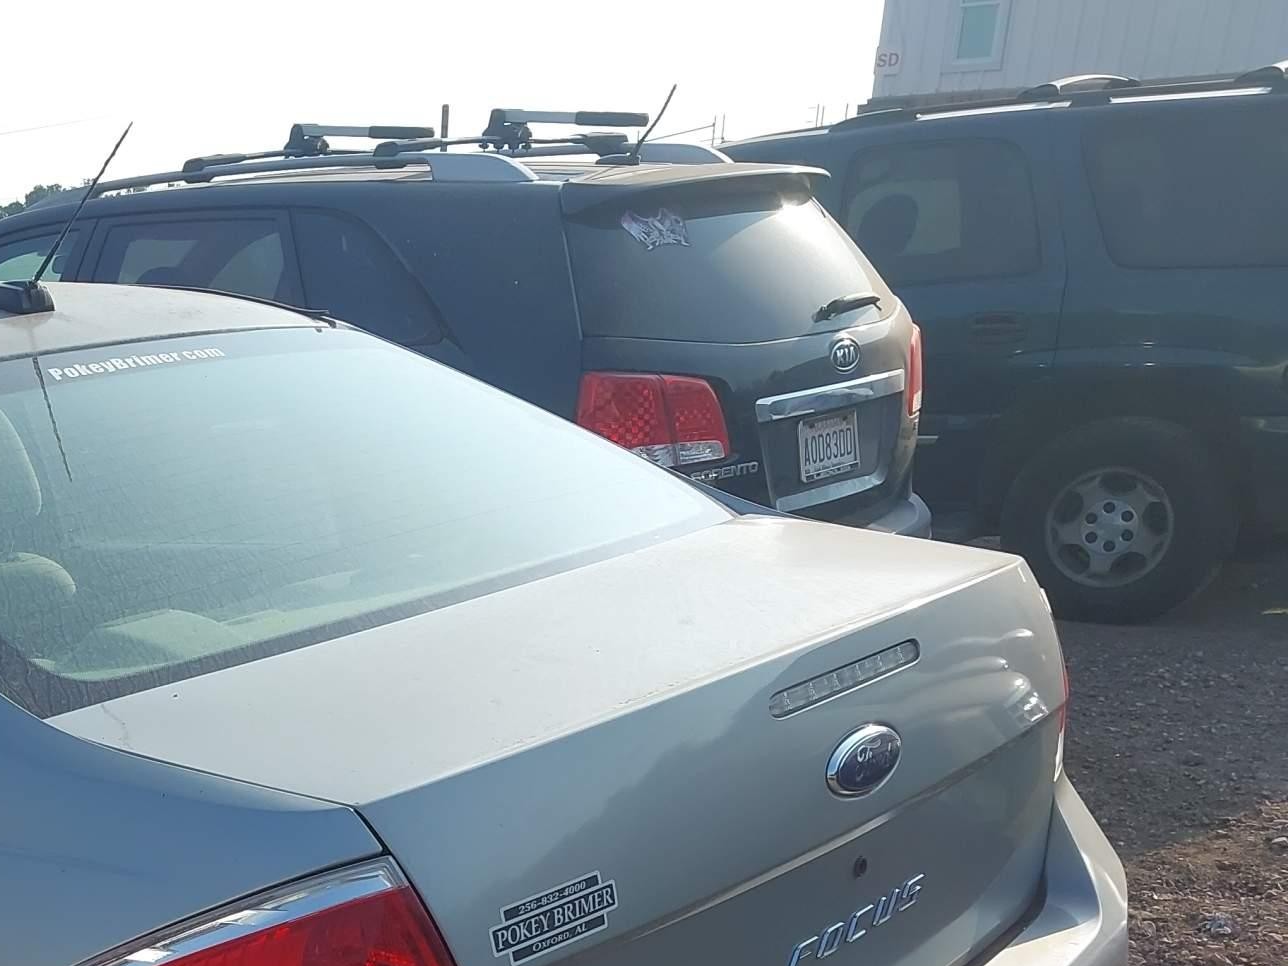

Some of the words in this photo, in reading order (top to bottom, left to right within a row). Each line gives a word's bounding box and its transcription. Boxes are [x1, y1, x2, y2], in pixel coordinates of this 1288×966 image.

[836, 346, 856, 366] KIA
[497, 912, 551, 950] POKEY
[552, 887, 614, 927] BRIMER
[574, 923, 588, 936] AL
